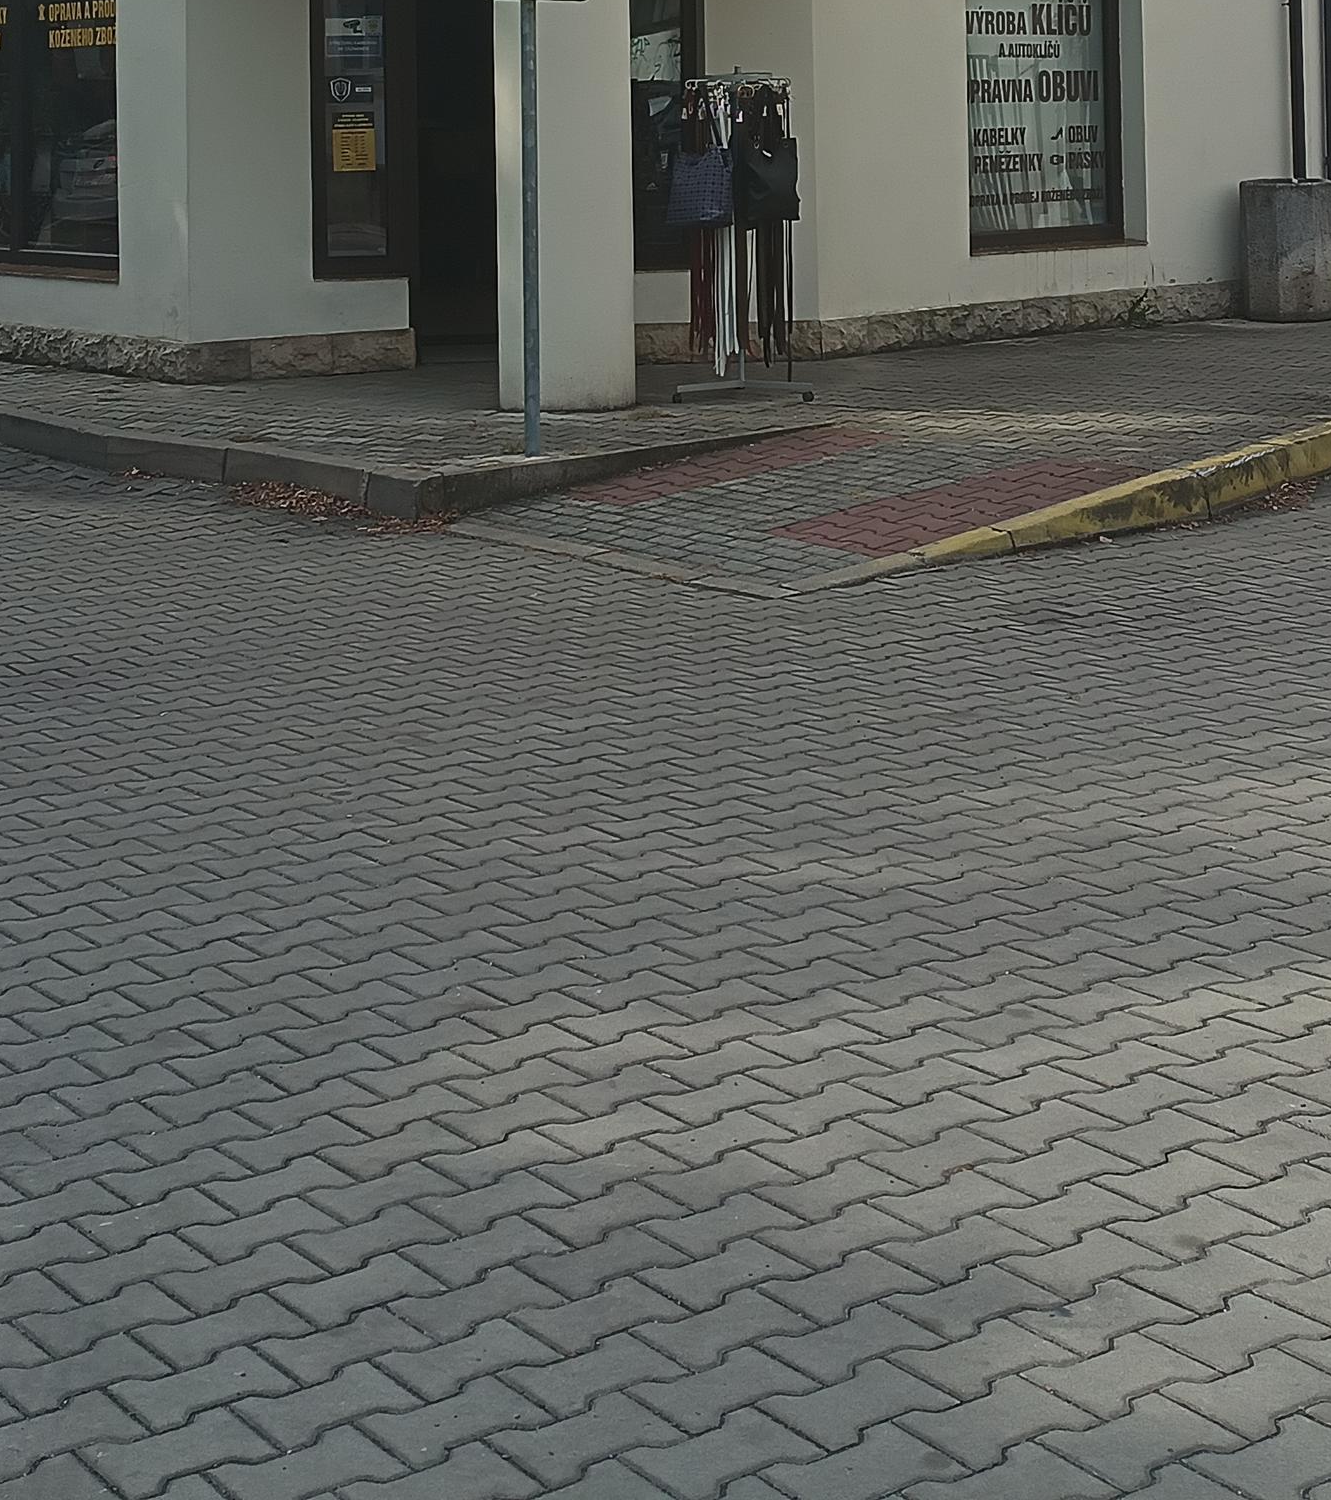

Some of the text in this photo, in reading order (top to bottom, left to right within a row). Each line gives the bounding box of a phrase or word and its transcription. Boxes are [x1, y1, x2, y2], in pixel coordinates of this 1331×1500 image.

[48, 1, 82, 22] OPRAVA
[84, 1, 91, 20] A
[965, 5, 1027, 35] VÝROBA
[968, 70, 1099, 104] PRAVNA OBUVI
[973, 125, 1098, 147] KABELKY OBUV
[974, 148, 1106, 174] PENĚŽENKY PÁSKY
